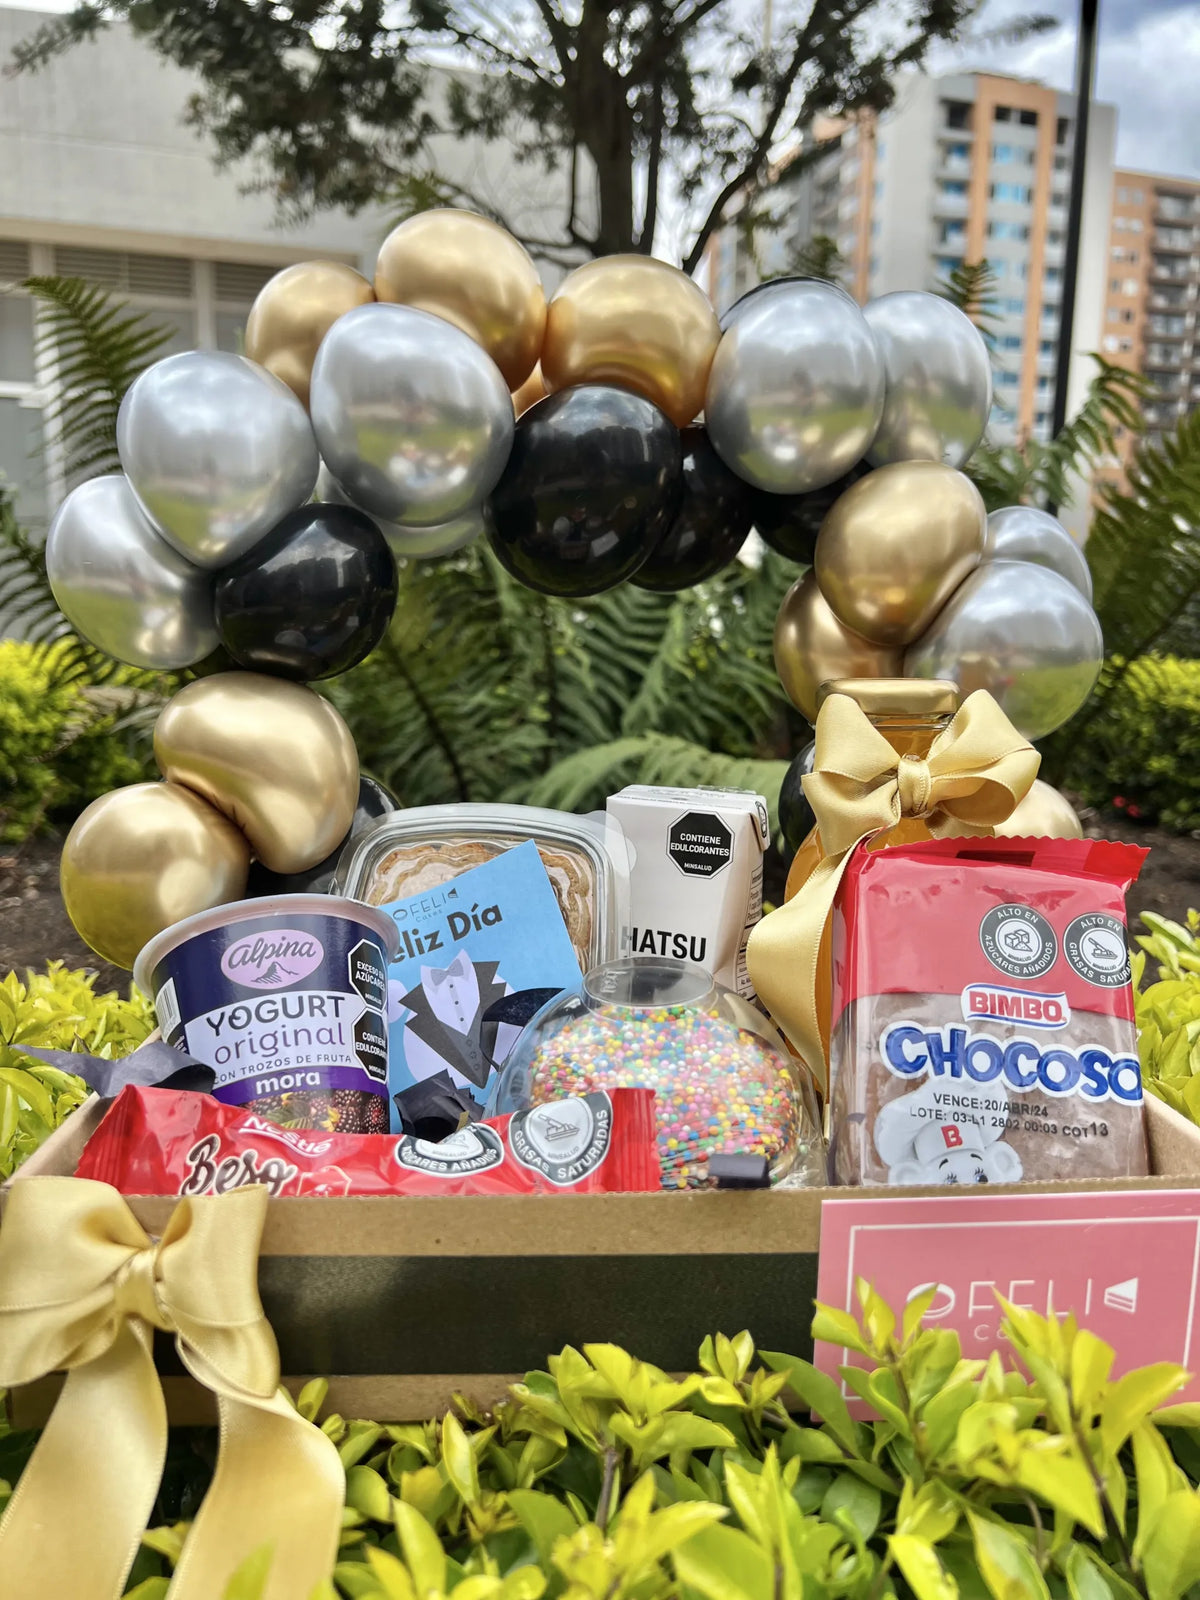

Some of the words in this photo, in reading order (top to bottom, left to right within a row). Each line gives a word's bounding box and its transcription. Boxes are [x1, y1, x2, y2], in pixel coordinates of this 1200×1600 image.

[670, 842, 730, 857] EDULCORANTES
[680, 832, 722, 845] CONTIENE
[683, 862, 712, 872] MINSALUD
[446, 902, 503, 942] Día
[997, 907, 1022, 920] ALTO
[1024, 911, 1039, 924] EN
[1080, 917, 1104, 930] ALTO
[1107, 920, 1121, 932] EN
[984, 934, 1020, 974] AZÚCARES
[1022, 941, 1053, 975] AÑADIDOS
[1069, 941, 1095, 979] GRASAS
[356, 960, 379, 976] EXCESO
[206, 994, 346, 1037] YOGURT
[969, 991, 1063, 1020] BIMBO
[214, 1022, 346, 1065] original
[240, 1057, 292, 1075] TROZOS
[296, 1054, 312, 1064] DE
[317, 1053, 352, 1064] FRUTA
[885, 1027, 1144, 1101] CHOCOSO
[255, 1070, 321, 1095] mora
[910, 1105, 947, 1121] LOTE:
[990, 1116, 1020, 1129] 2802
[514, 1130, 550, 1173] GRASAS
[557, 1109, 609, 1179] SATURADAS
[940, 1124, 964, 1149] B
